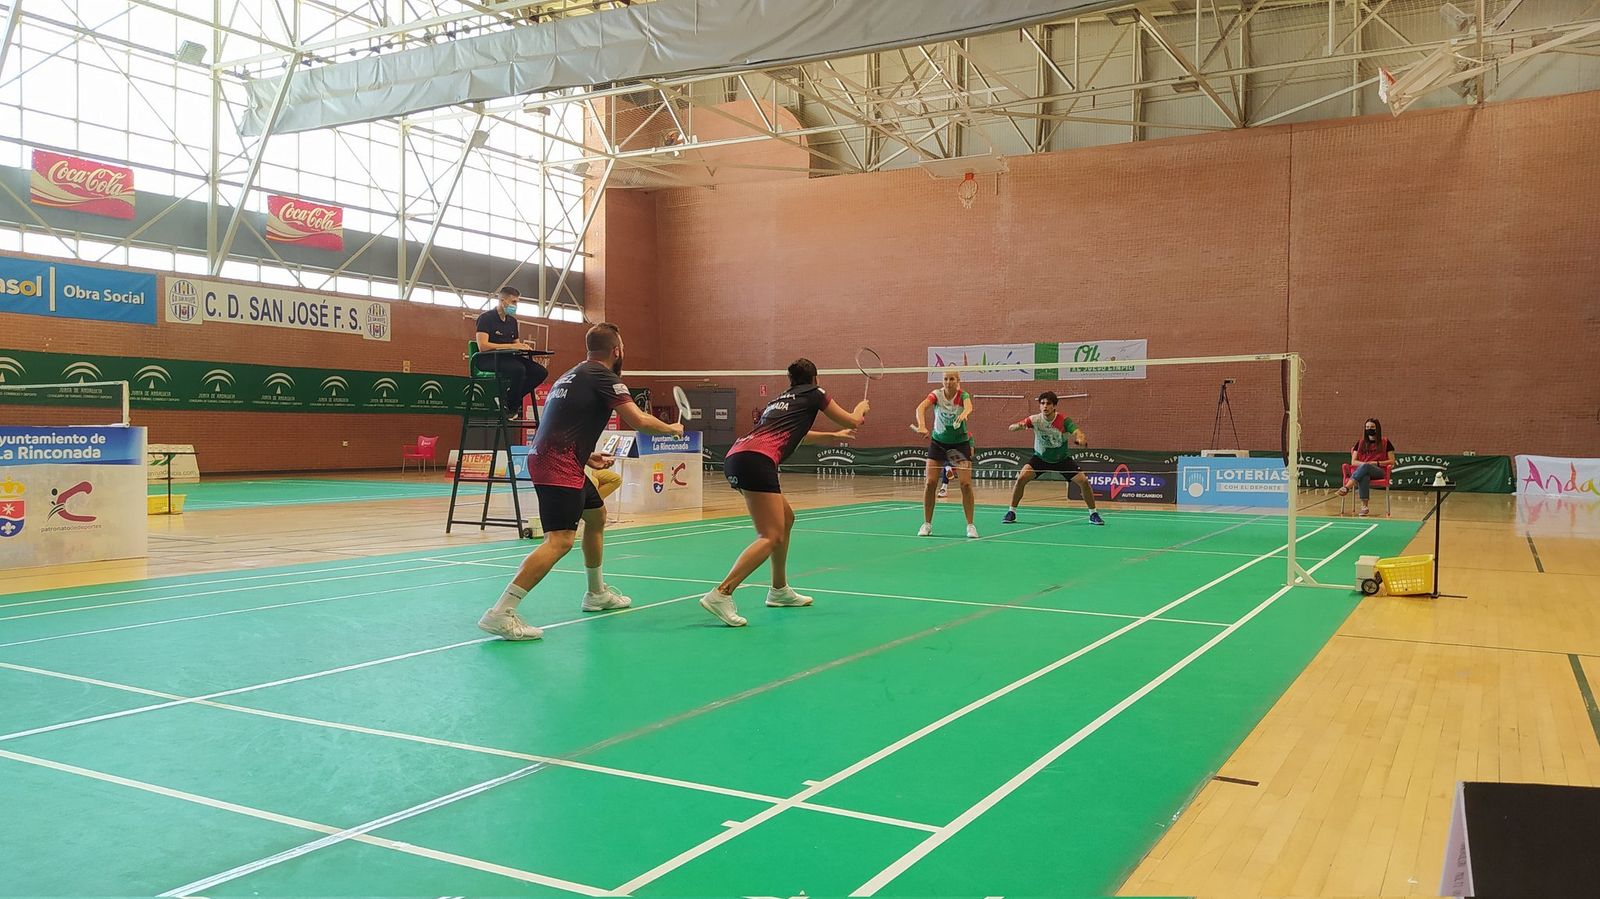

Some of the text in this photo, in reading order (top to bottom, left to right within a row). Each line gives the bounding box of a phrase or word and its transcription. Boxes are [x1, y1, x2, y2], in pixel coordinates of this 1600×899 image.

[63, 284, 145, 305] Obra Social
[249, 296, 283, 323] SAN
[288, 299, 329, 327] JOSÉ
[90, 433, 106, 444] de
[0, 446, 101, 460] a Rinconada
[976, 450, 1021, 461] DIPUTACION
[1216, 467, 1289, 481] LOTERÍAS
[1087, 476, 1160, 487] HISPALIS S.L.
